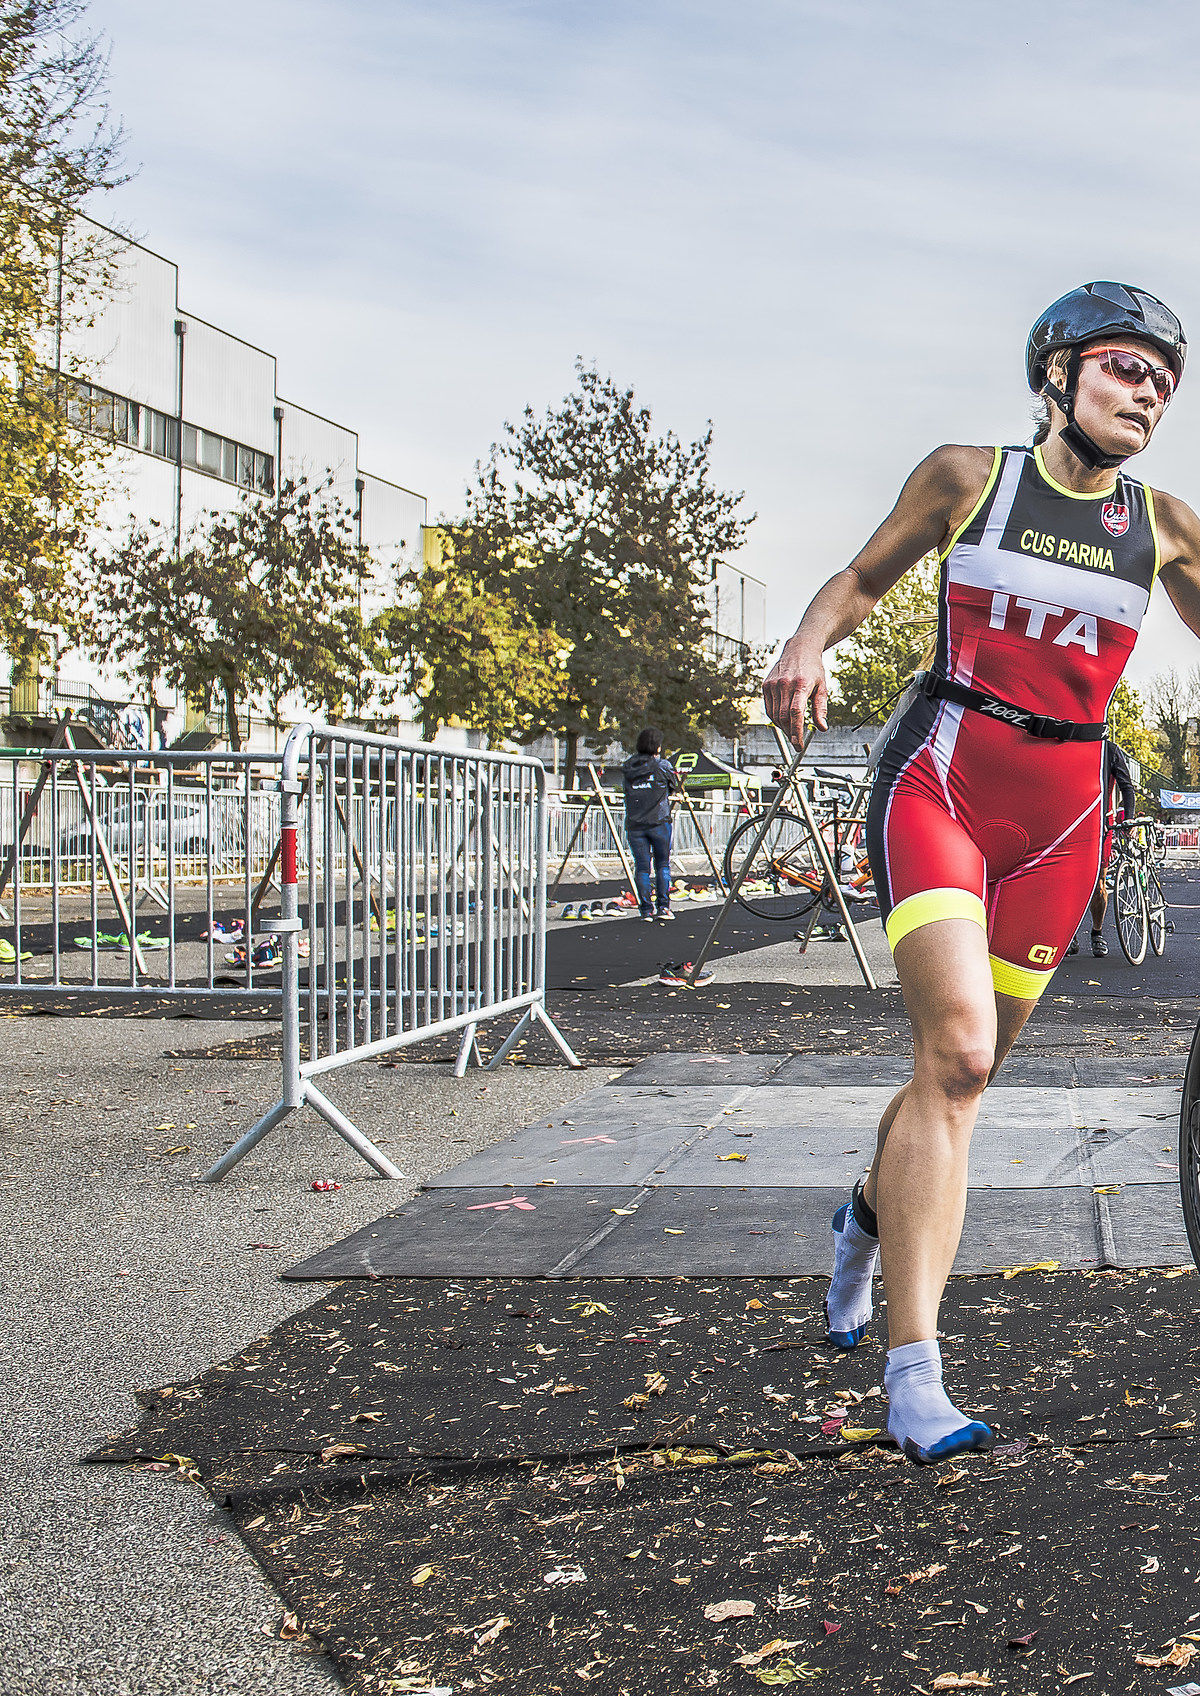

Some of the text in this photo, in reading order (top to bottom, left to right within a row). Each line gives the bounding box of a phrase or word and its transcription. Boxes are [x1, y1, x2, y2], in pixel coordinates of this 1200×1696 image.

[1020, 528, 1115, 572] CUS PARMA
[988, 592, 1099, 657] ITA
